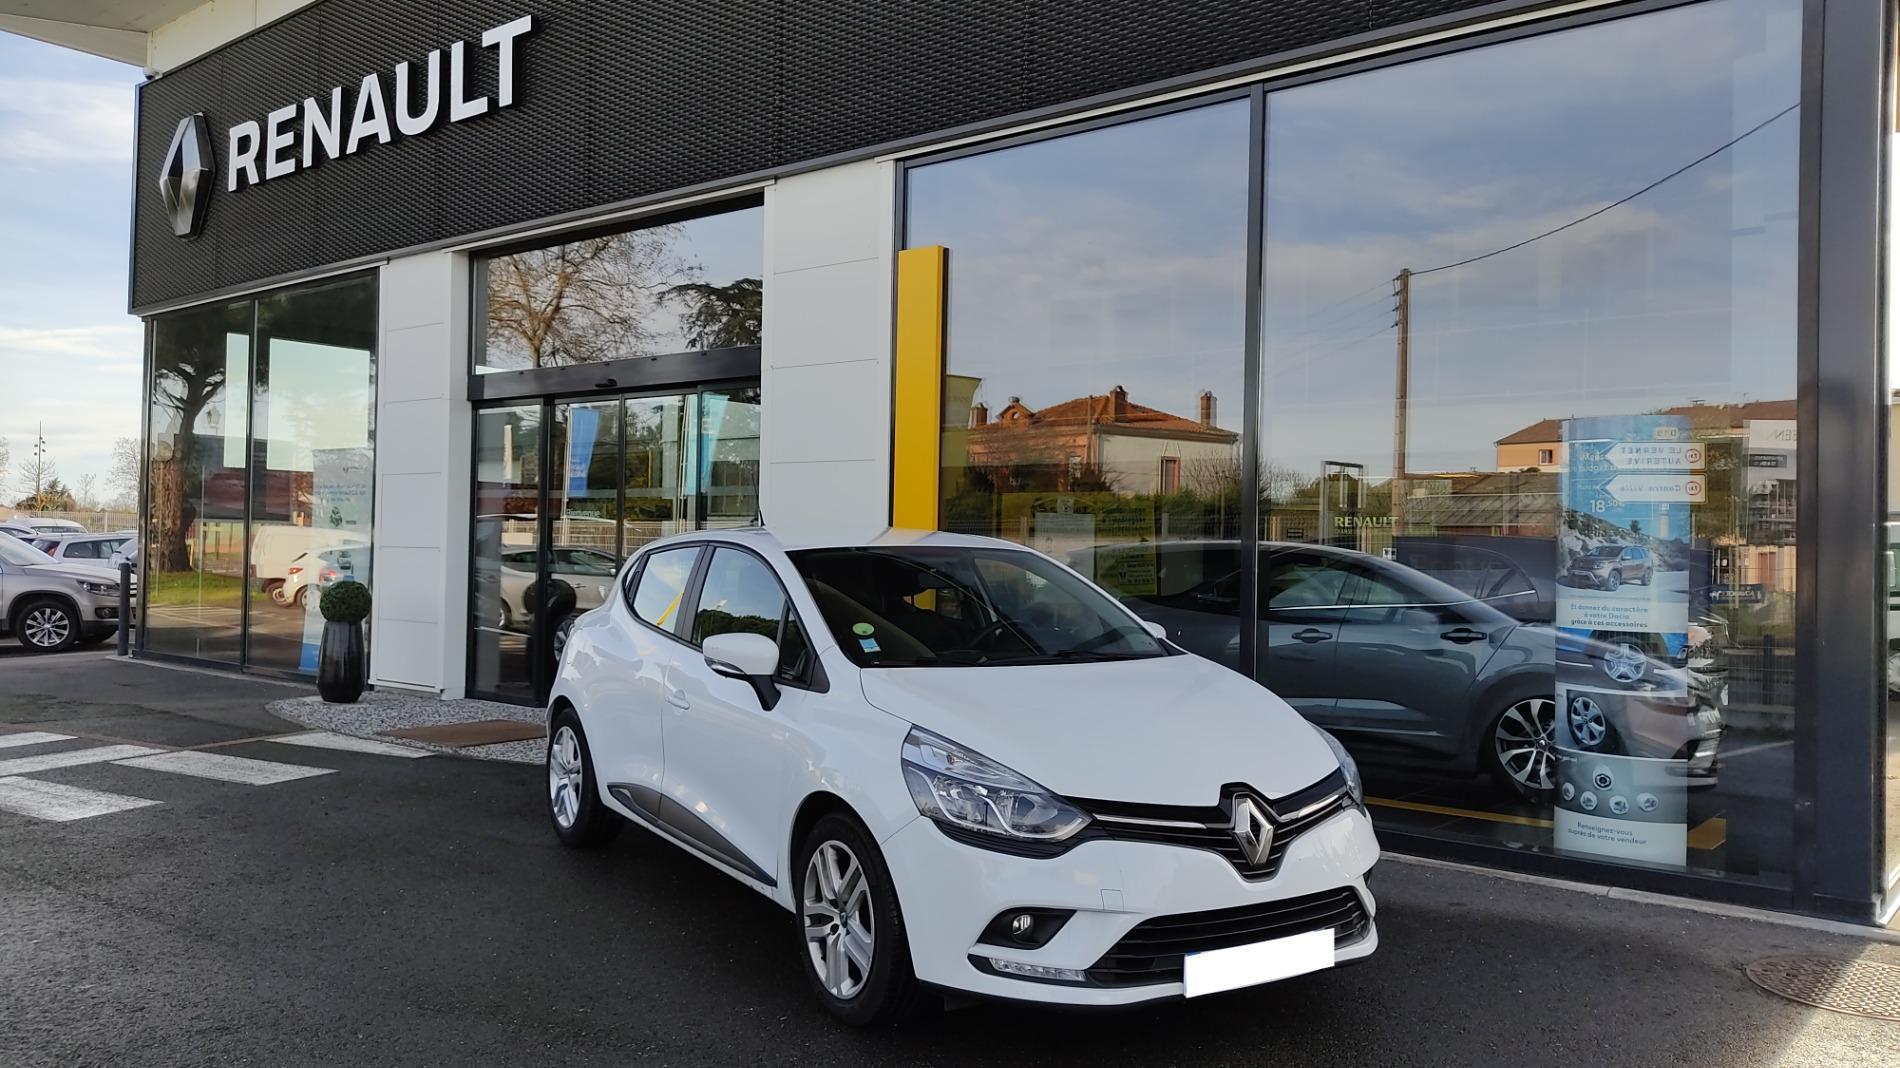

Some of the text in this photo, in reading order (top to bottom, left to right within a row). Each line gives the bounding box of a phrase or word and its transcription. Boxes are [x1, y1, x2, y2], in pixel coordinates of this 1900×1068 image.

[228, 14, 532, 193] RENAULT
[1334, 516, 1399, 528] RENAULT
[1612, 605, 1649, 613] caractère
[1605, 620, 1648, 628] accessoires
[1616, 837, 1647, 845] vendeur
